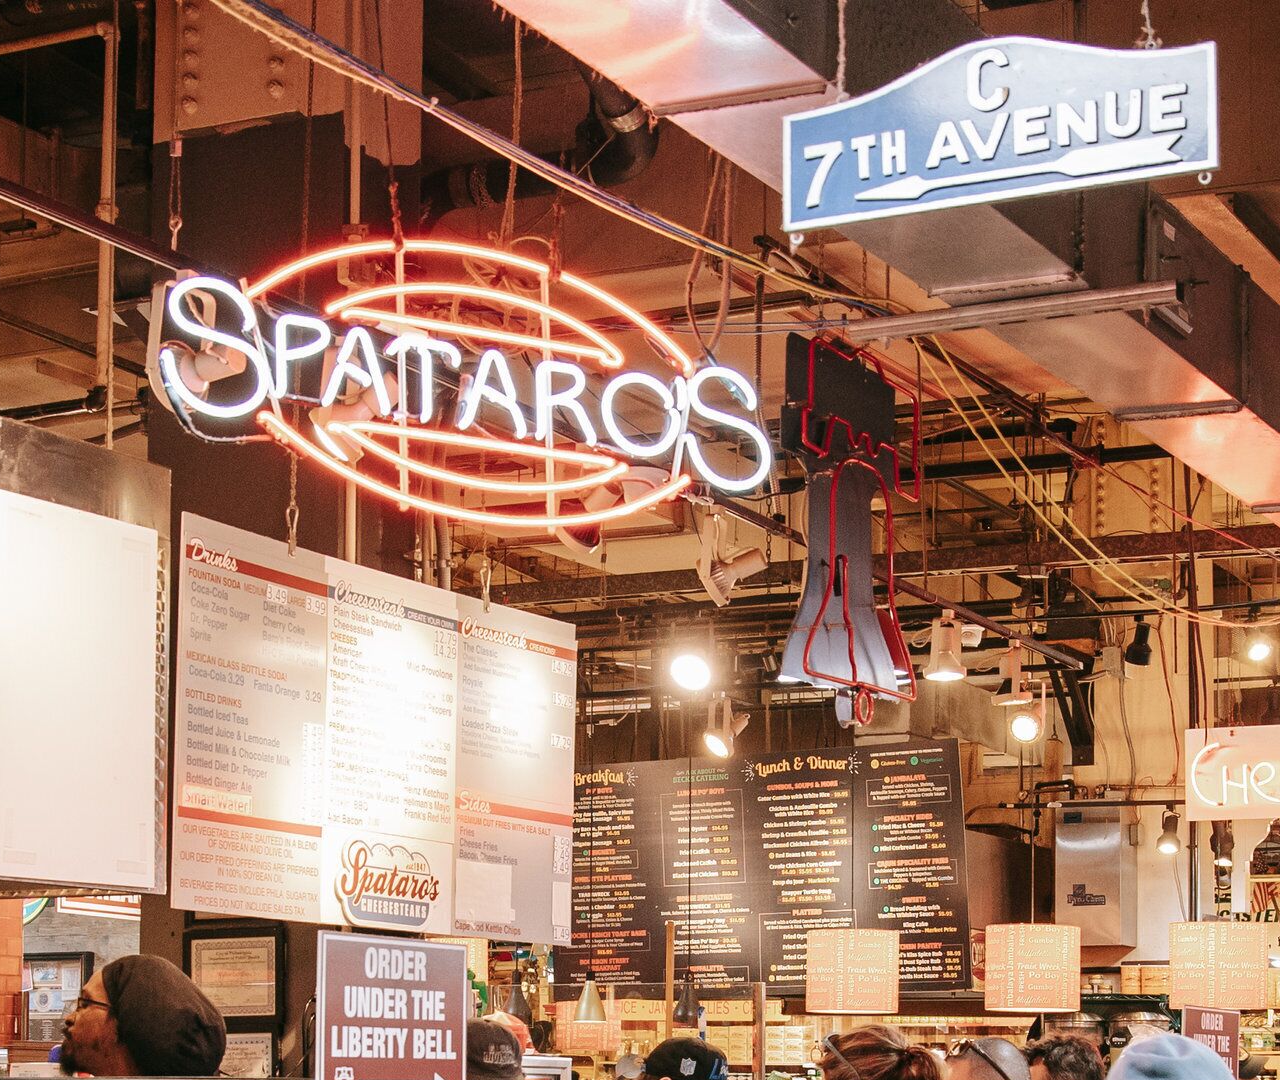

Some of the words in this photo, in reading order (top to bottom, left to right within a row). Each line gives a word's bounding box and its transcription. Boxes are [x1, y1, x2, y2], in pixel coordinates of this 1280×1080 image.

[968, 48, 1010, 113] C
[925, 83, 1188, 170] AVENUE
[191, 537, 238, 572] Drinks
[189, 568, 221, 585] FOUNTAIN
[222, 577, 240, 590] SODA
[191, 582, 228, 600] Coca-Cola
[334, 580, 406, 619] Cheesesteak
[461, 616, 527, 650] Cheesesteak
[189, 664, 226, 683] Coca-Cola
[228, 672, 244, 686] 3.29
[186, 688, 215, 702] BOTTLED
[188, 704, 213, 718] Bottled
[188, 721, 213, 735] Bottled
[243, 731, 280, 748] Lemonade
[187, 738, 213, 753] Bottled
[239, 748, 274, 763] Chocolate
[187, 755, 213, 769] Bottled
[755, 759, 791, 777] Lunch
[794, 757, 804, 770] &
[807, 756, 847, 770] Dinner
[186, 772, 213, 787] Bottled
[575, 769, 624, 786] Breakfast
[459, 790, 491, 813] Sides
[341, 847, 439, 905] Spataro's
[361, 899, 427, 918] CHEESESTEAKS
[365, 947, 427, 982] ORDER
[344, 985, 408, 1020] UNDER
[411, 989, 446, 1021] THE
[1201, 1012, 1224, 1031] ORDER
[331, 1025, 409, 1059] LIBERTY
[412, 1028, 457, 1060] BELL
[1217, 1035, 1230, 1053] THE
